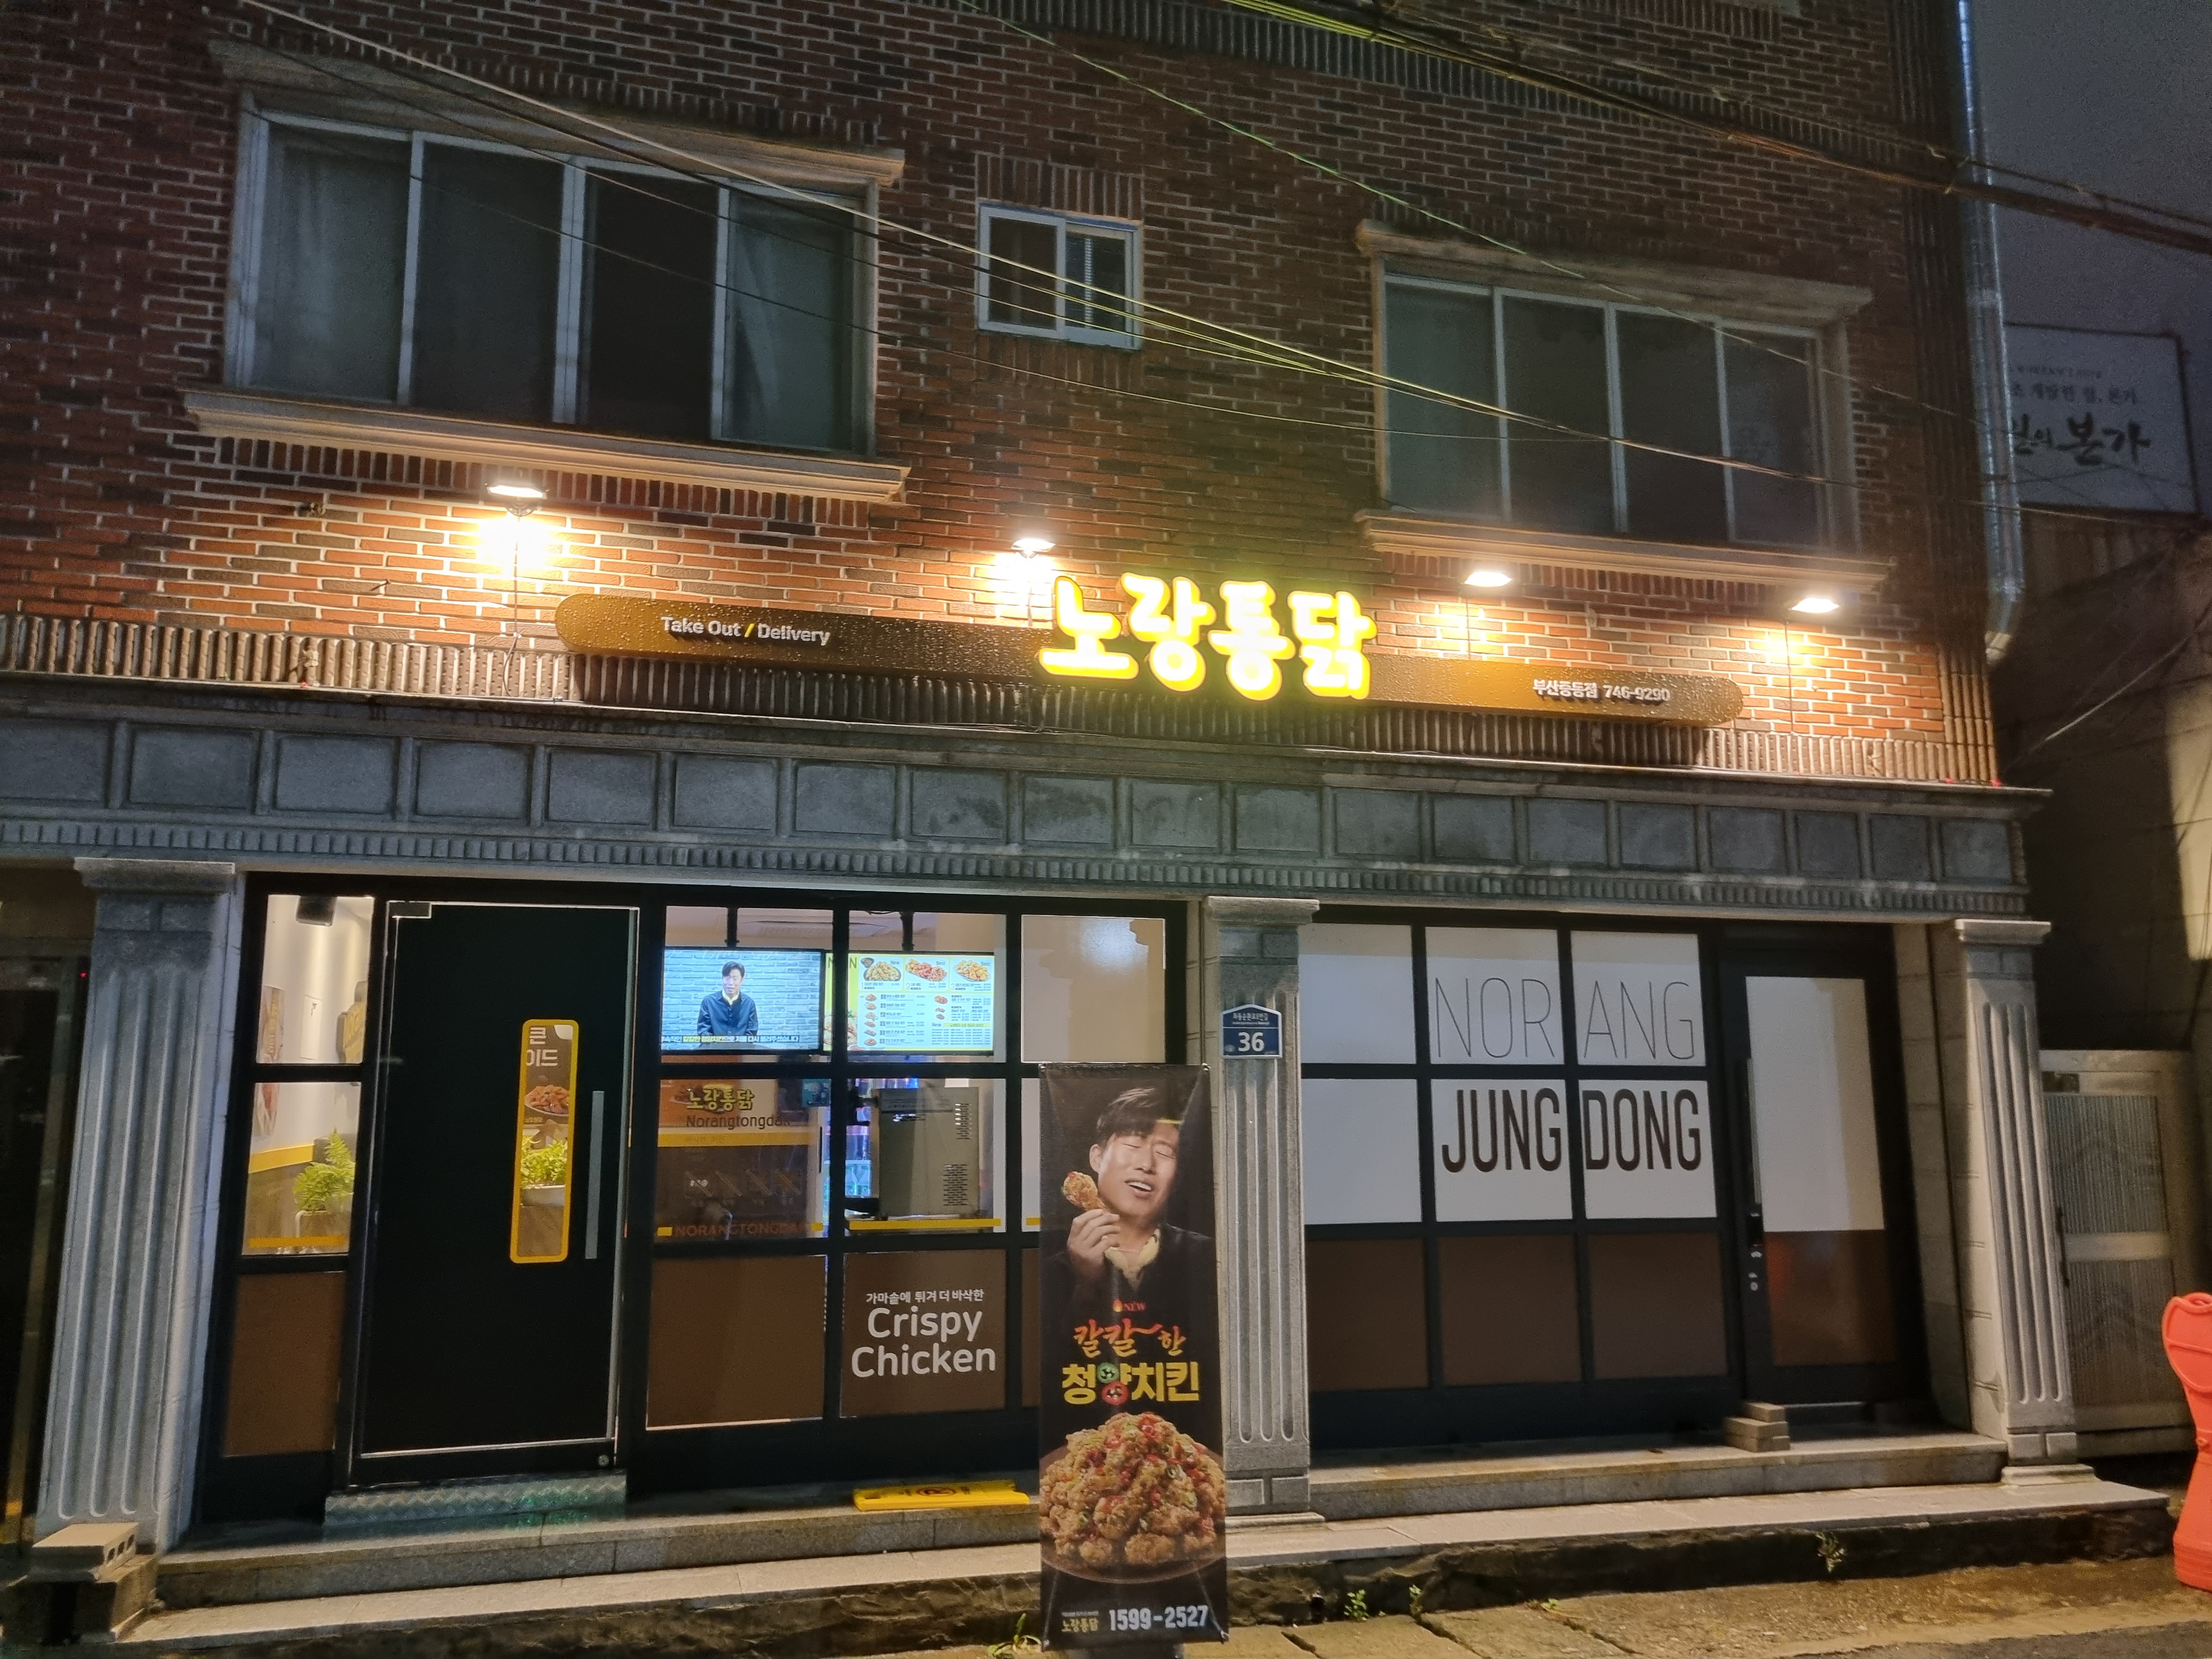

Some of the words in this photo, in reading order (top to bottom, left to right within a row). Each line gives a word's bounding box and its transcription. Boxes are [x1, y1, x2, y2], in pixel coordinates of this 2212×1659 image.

[661, 616, 704, 634] Take
[708, 620, 742, 636] Out
[757, 623, 831, 646] Delivery
[1039, 572, 1378, 701] 노랑통닭
[1533, 679, 1599, 699] 부산중동점
[1602, 685, 1671, 701] 746-9290
[1238, 1032, 1265, 1052] 36
[686, 1085, 755, 1111] 노랑통닭
[866, 1291, 911, 1305] 가마솥에
[915, 1290, 937, 1302] 튀겨
[939, 1290, 950, 1301] 더
[951, 1289, 985, 1301] 바삭한
[867, 1305, 983, 1342] Crispy
[851, 1342, 996, 1378] Chicken
[1062, 1361, 1200, 1406] 청양치킨
[1108, 1604, 1209, 1632] 1599-2527
